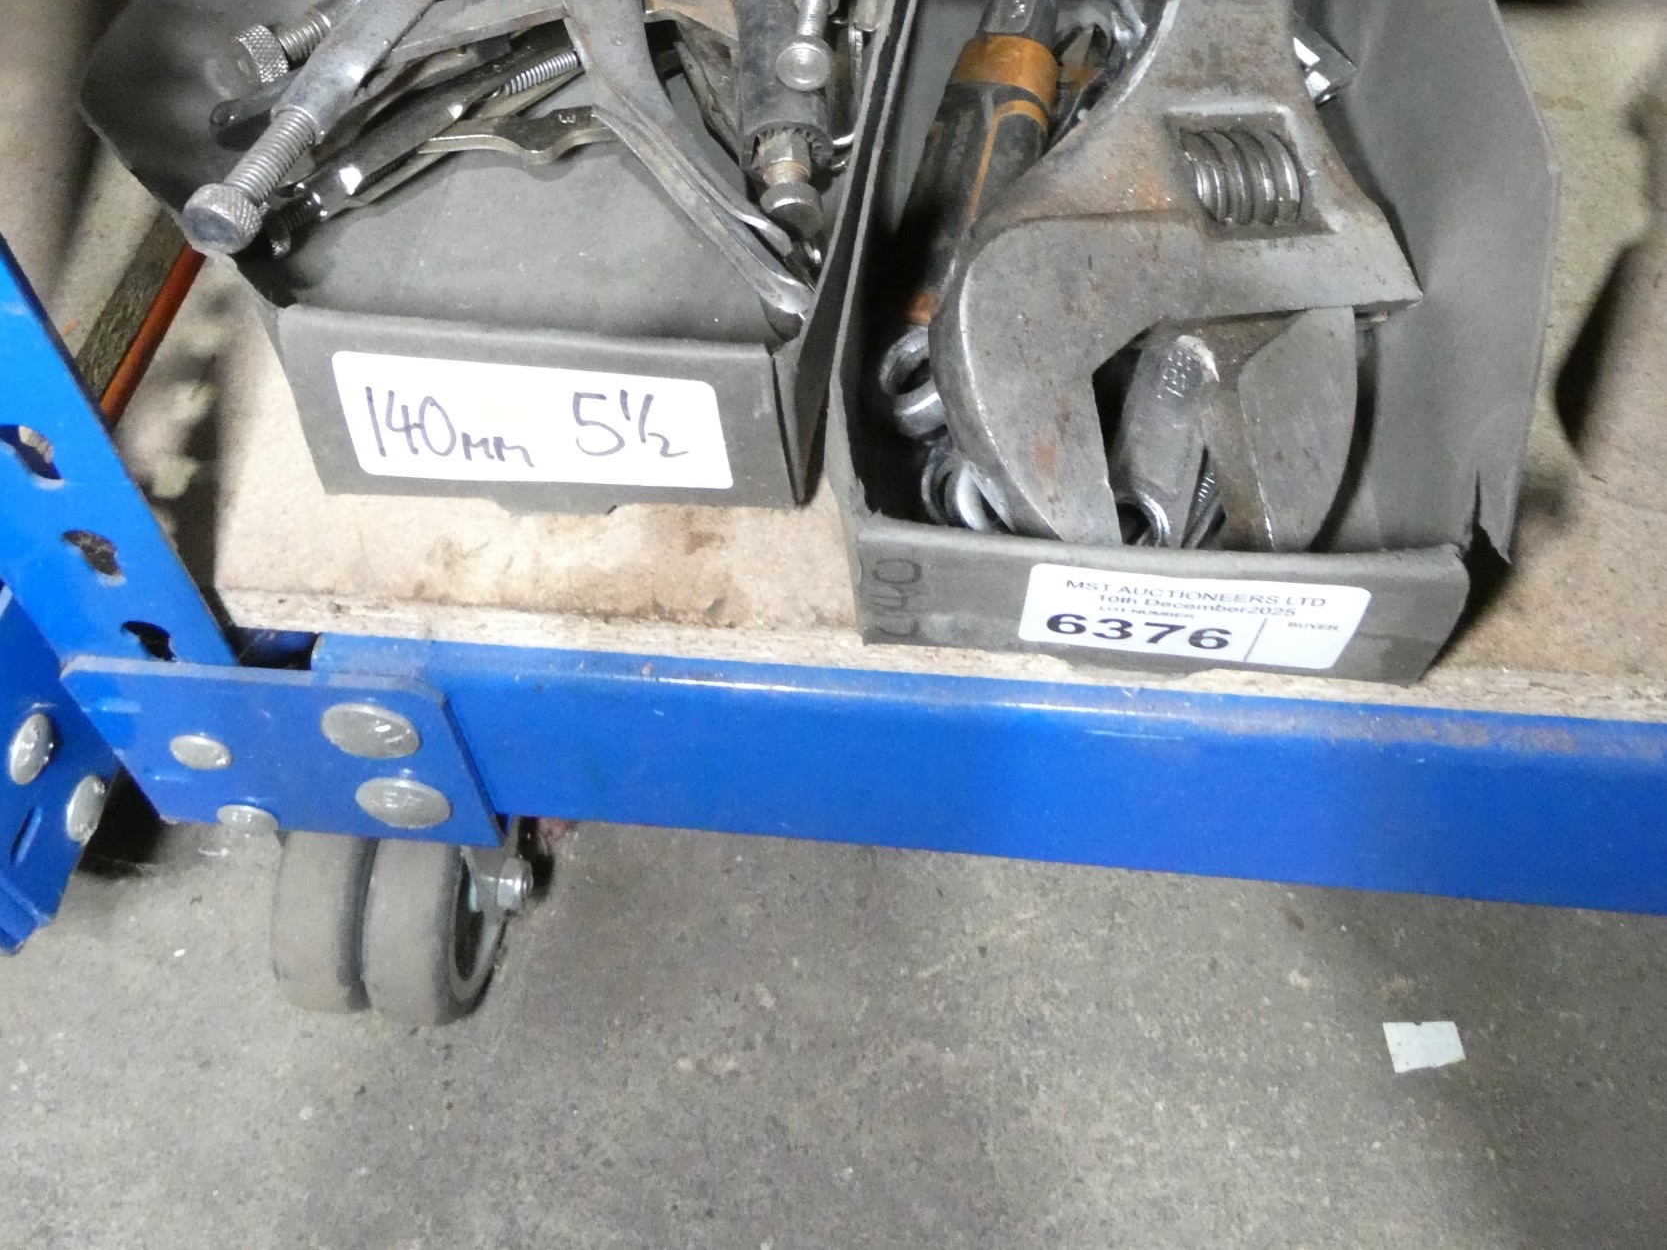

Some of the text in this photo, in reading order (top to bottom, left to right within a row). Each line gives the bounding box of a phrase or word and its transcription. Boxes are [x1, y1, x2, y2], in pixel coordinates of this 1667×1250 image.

[1065, 579, 1327, 608] MST AUCTIONEERS LTD
[1098, 594, 1138, 605] 10th
[1099, 606, 1196, 620] LOT NUMBER
[1046, 613, 1234, 651] 6376
[1287, 621, 1340, 632] BUYER
